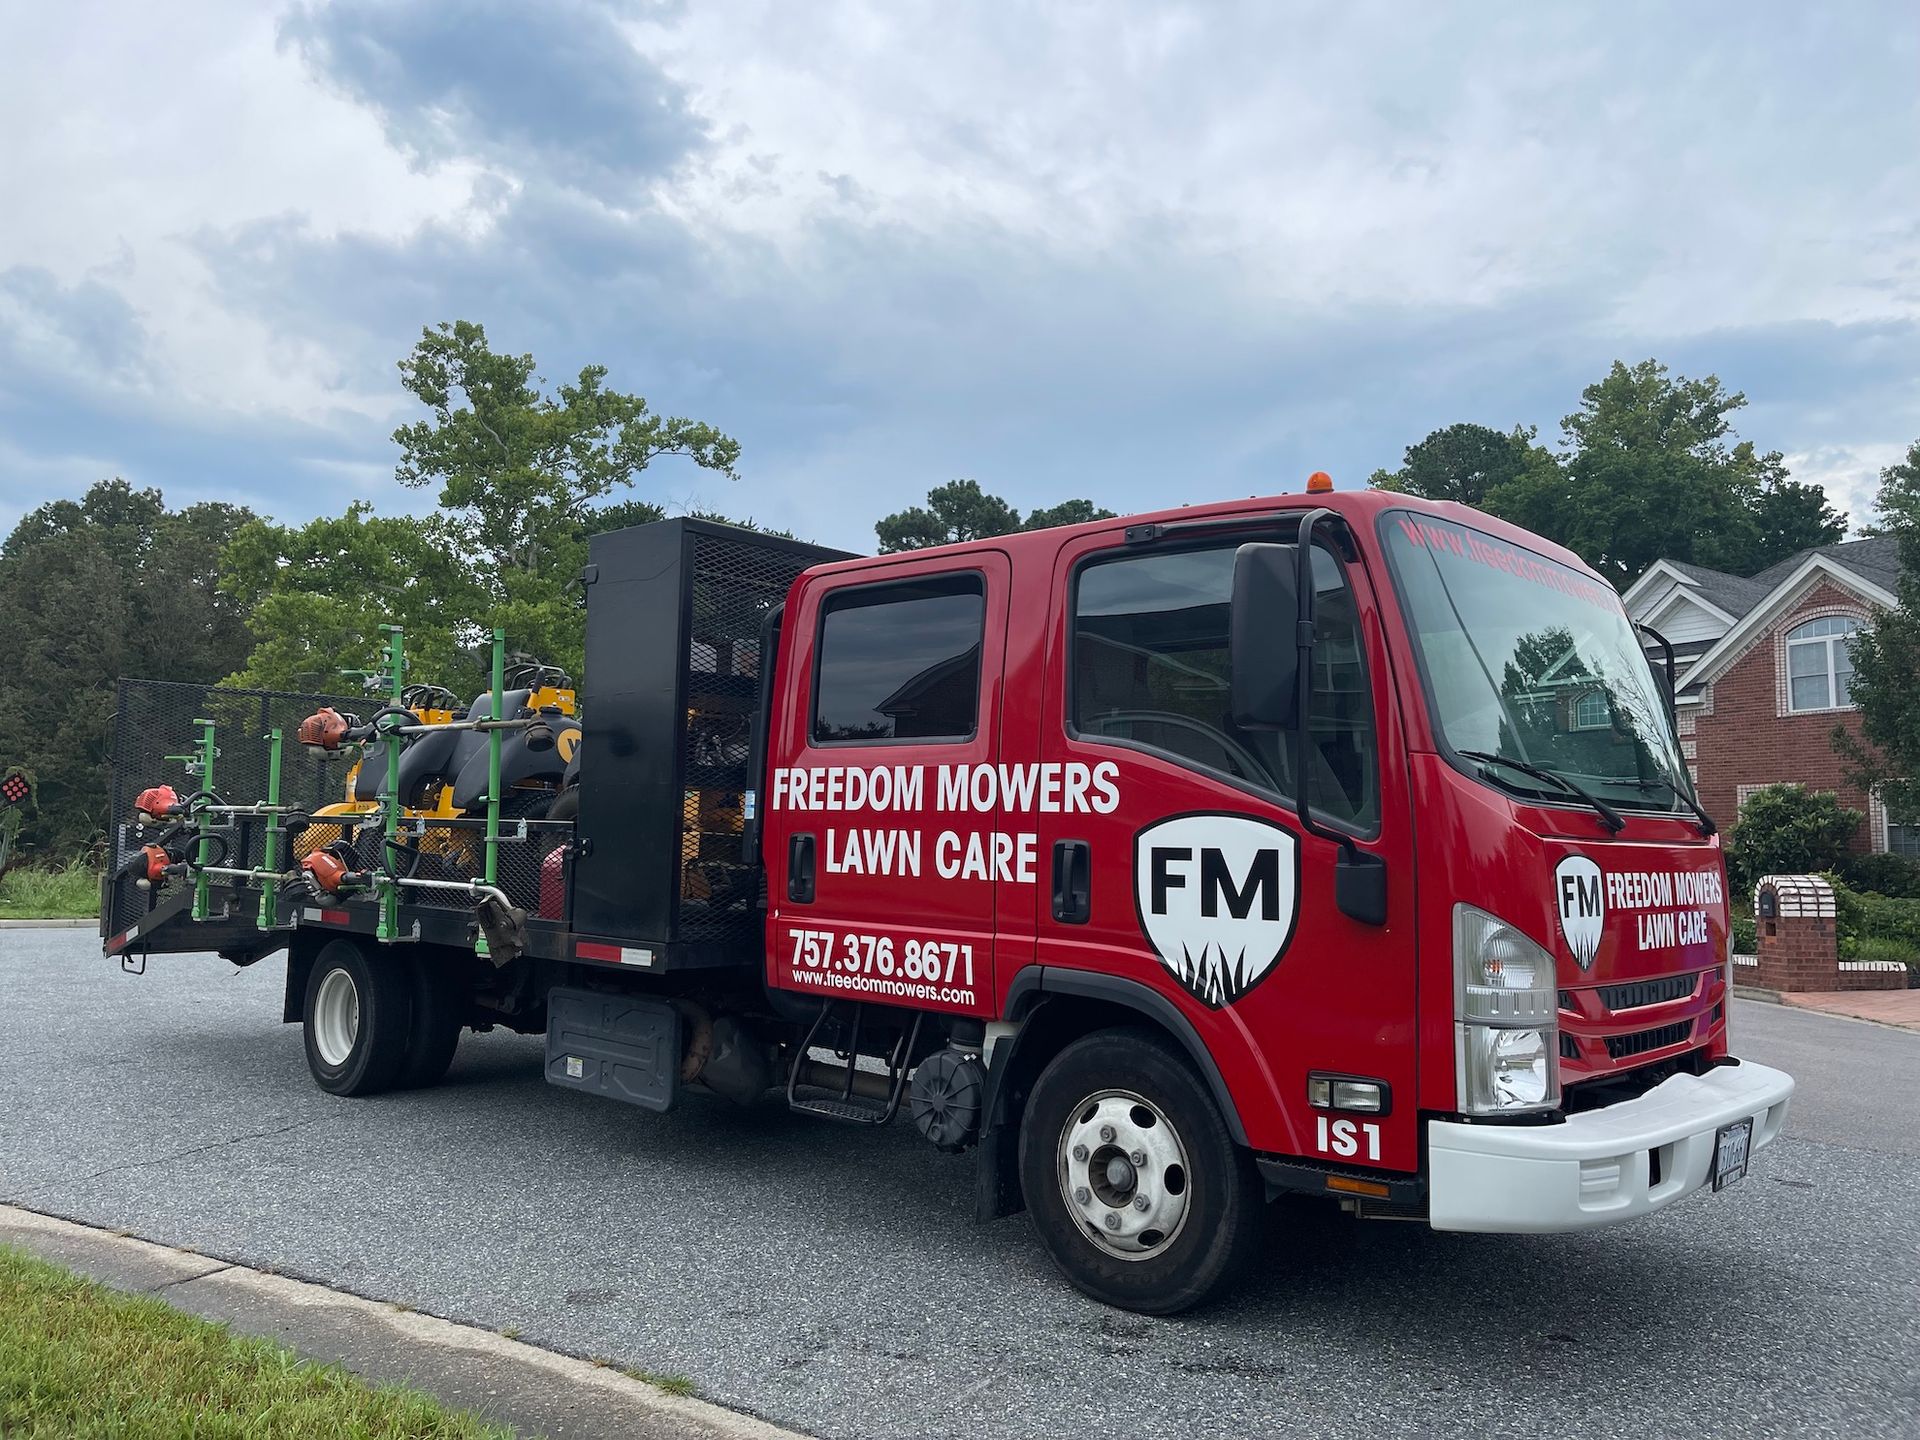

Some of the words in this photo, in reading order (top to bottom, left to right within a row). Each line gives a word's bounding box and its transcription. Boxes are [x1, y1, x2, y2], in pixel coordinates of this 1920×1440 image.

[772, 764, 924, 812] FREEDOM
[936, 761, 1120, 814] MOWERS
[825, 828, 921, 877] LAWN
[935, 830, 1037, 884] CARE
[1151, 847, 1280, 921] FM
[1561, 875, 1601, 918] FM
[1606, 872, 1672, 909] FREEDOM
[1674, 871, 1723, 907] MOWERS
[1637, 913, 1675, 950] LAWN
[1678, 911, 1708, 946] CARE
[788, 928, 974, 986] 757.376.8671
[792, 968, 975, 1006] www.freedommowers.com
[1317, 1116, 1380, 1161] IS1
